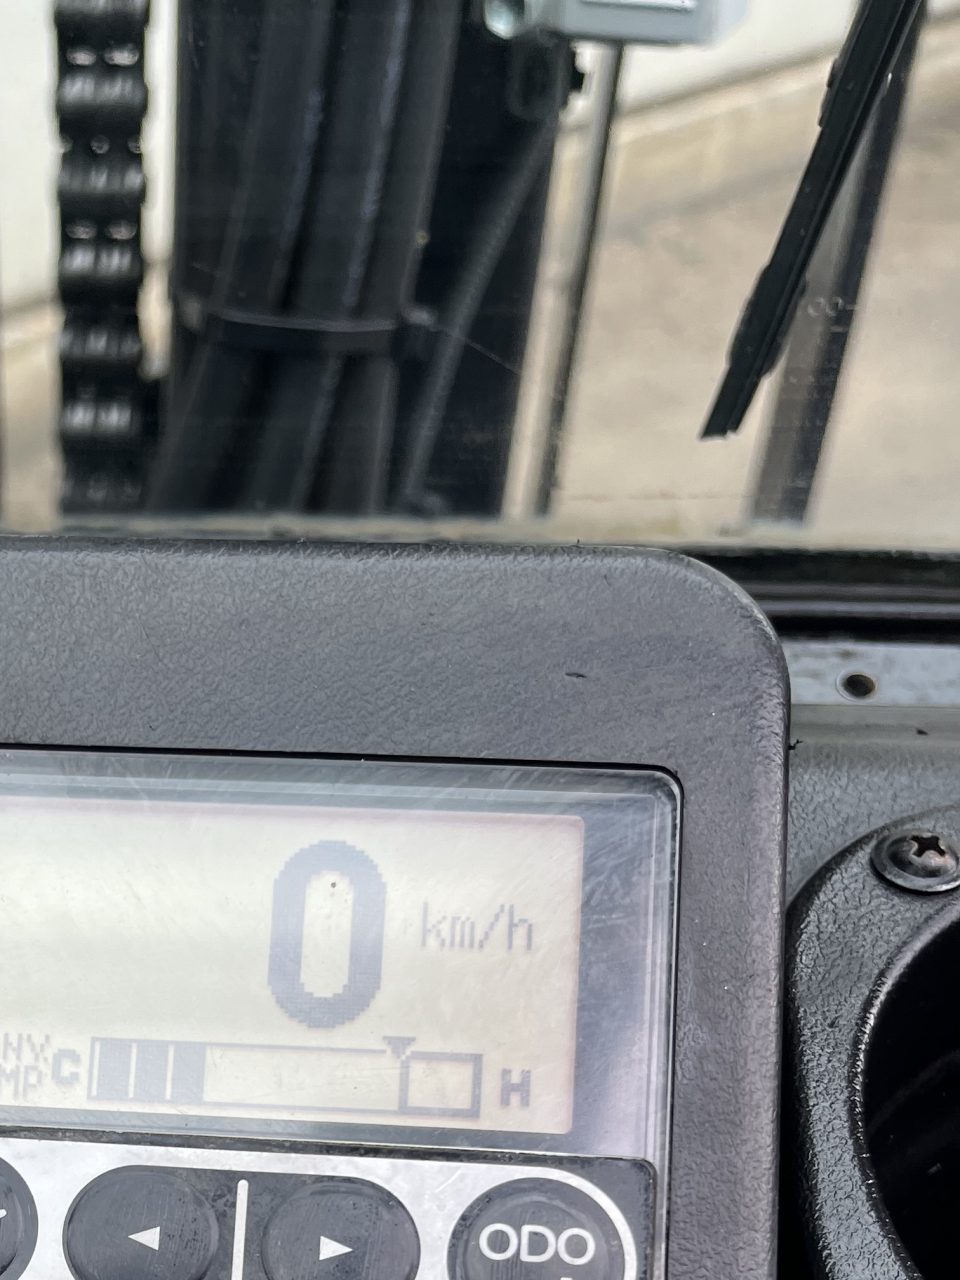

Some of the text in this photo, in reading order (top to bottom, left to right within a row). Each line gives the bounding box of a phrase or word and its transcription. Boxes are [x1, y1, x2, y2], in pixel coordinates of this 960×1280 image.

[268, 839, 533, 1029] 0 km/h
[50, 1048, 81, 1087] C
[499, 1067, 532, 1107] H
[478, 1222, 596, 1266] ODO
